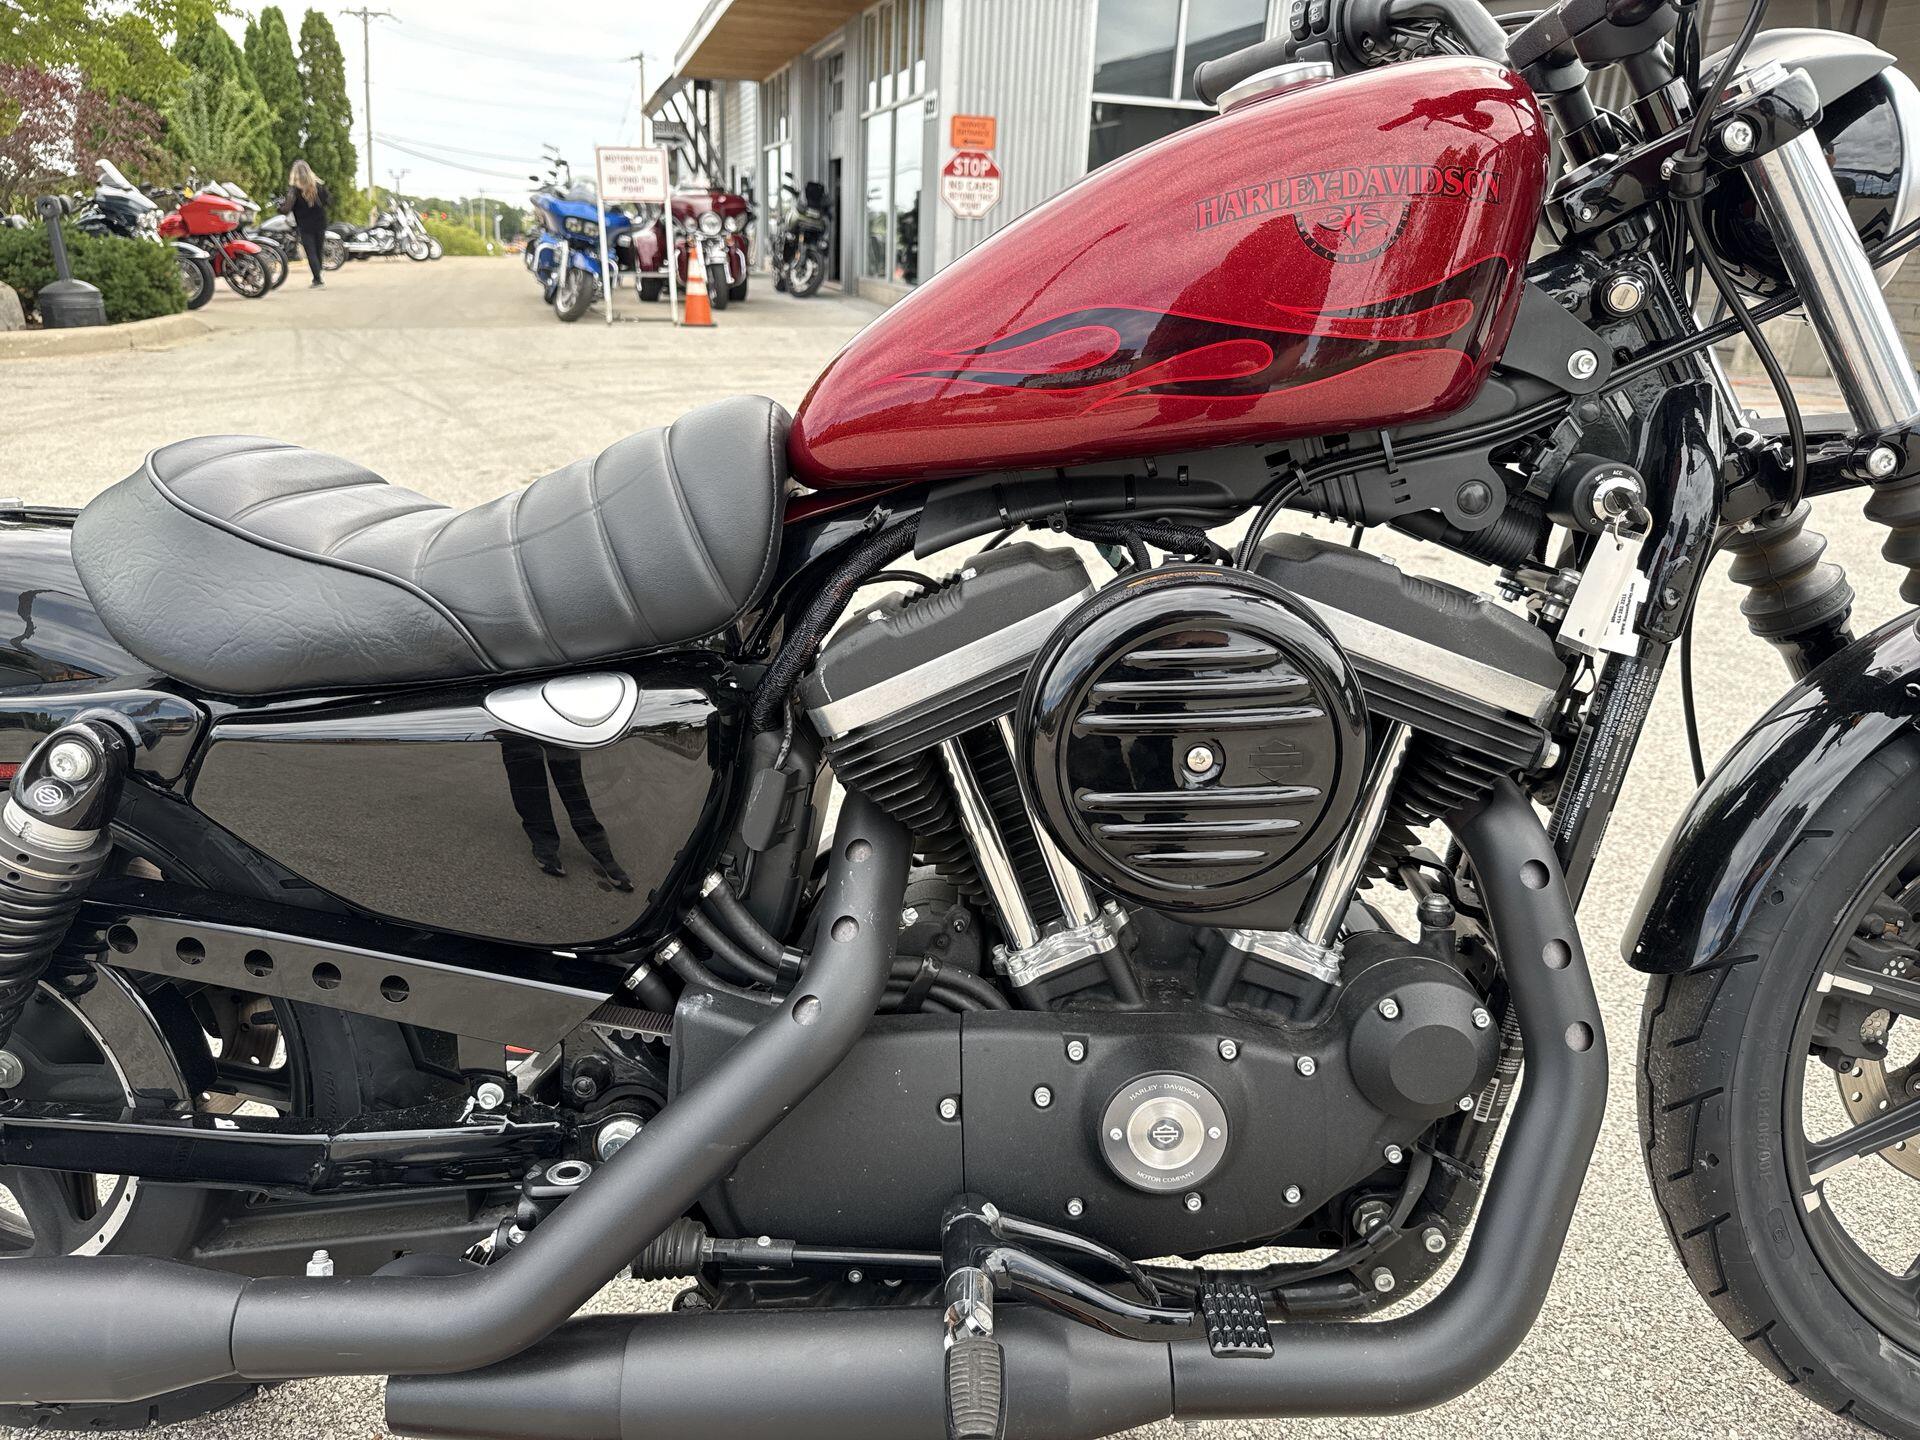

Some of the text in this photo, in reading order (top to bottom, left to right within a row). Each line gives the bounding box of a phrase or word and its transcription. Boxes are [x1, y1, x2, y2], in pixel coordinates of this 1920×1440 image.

[952, 158, 992, 176] STOP
[949, 181, 964, 190] NO
[1196, 165, 1501, 232] HARLEY-DAVIDSON
[1594, 472, 1604, 480] OFF
[1623, 674, 1634, 694] VEHICLE
[1598, 732, 1608, 750] EFFECT
[1590, 770, 1601, 791] FEDERAL
[1129, 1083, 1201, 1100] HARLEY DAVIDSON
[1136, 1171, 1195, 1182] MOTOR COMPANY
